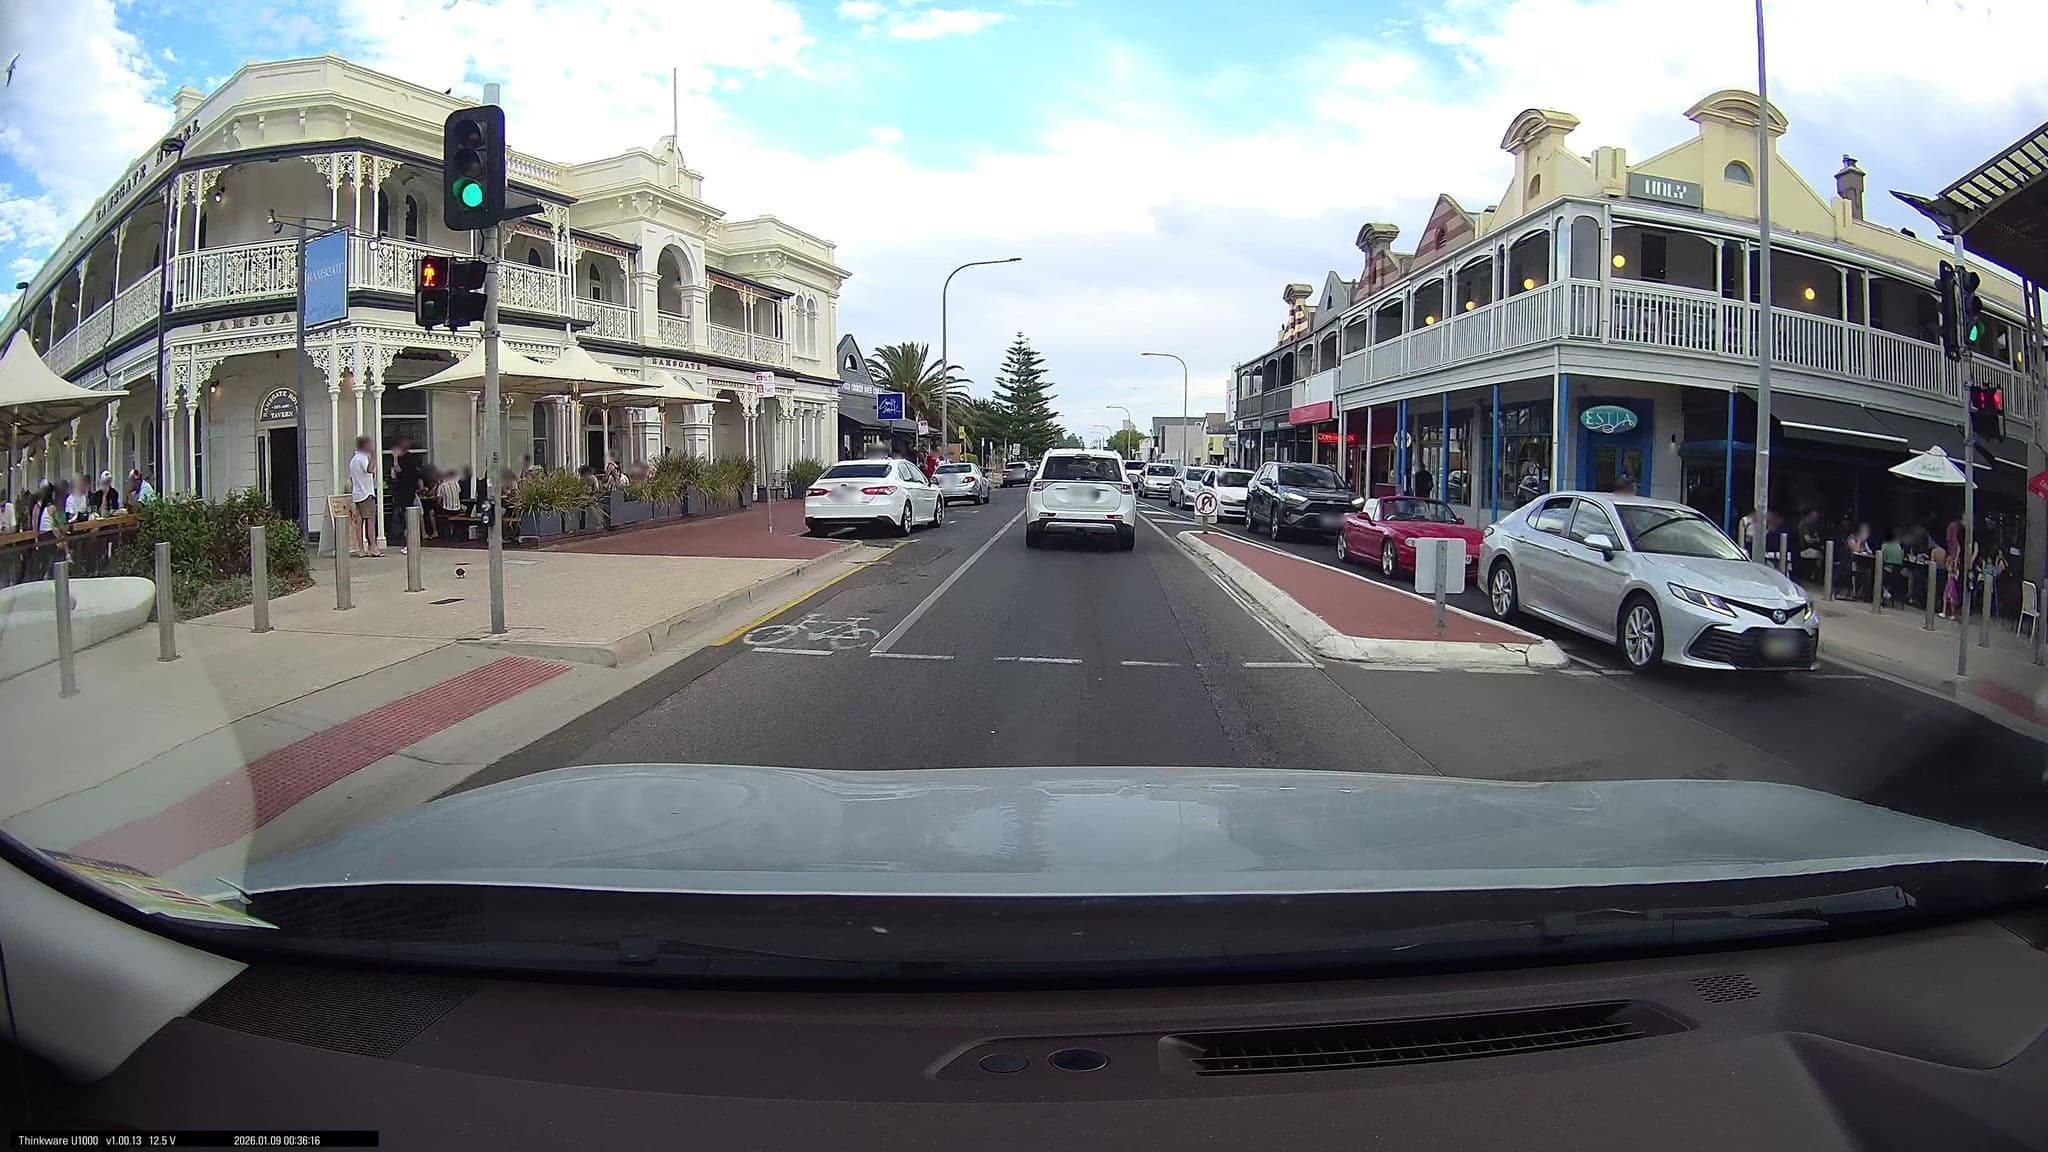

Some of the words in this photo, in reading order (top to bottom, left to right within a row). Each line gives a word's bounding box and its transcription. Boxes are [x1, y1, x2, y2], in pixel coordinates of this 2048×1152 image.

[202, 313, 293, 333] RAMSGA
[651, 357, 701, 370] RAMSGATE
[270, 410, 294, 419] TAVERN
[1585, 410, 1634, 428] ESTIA
